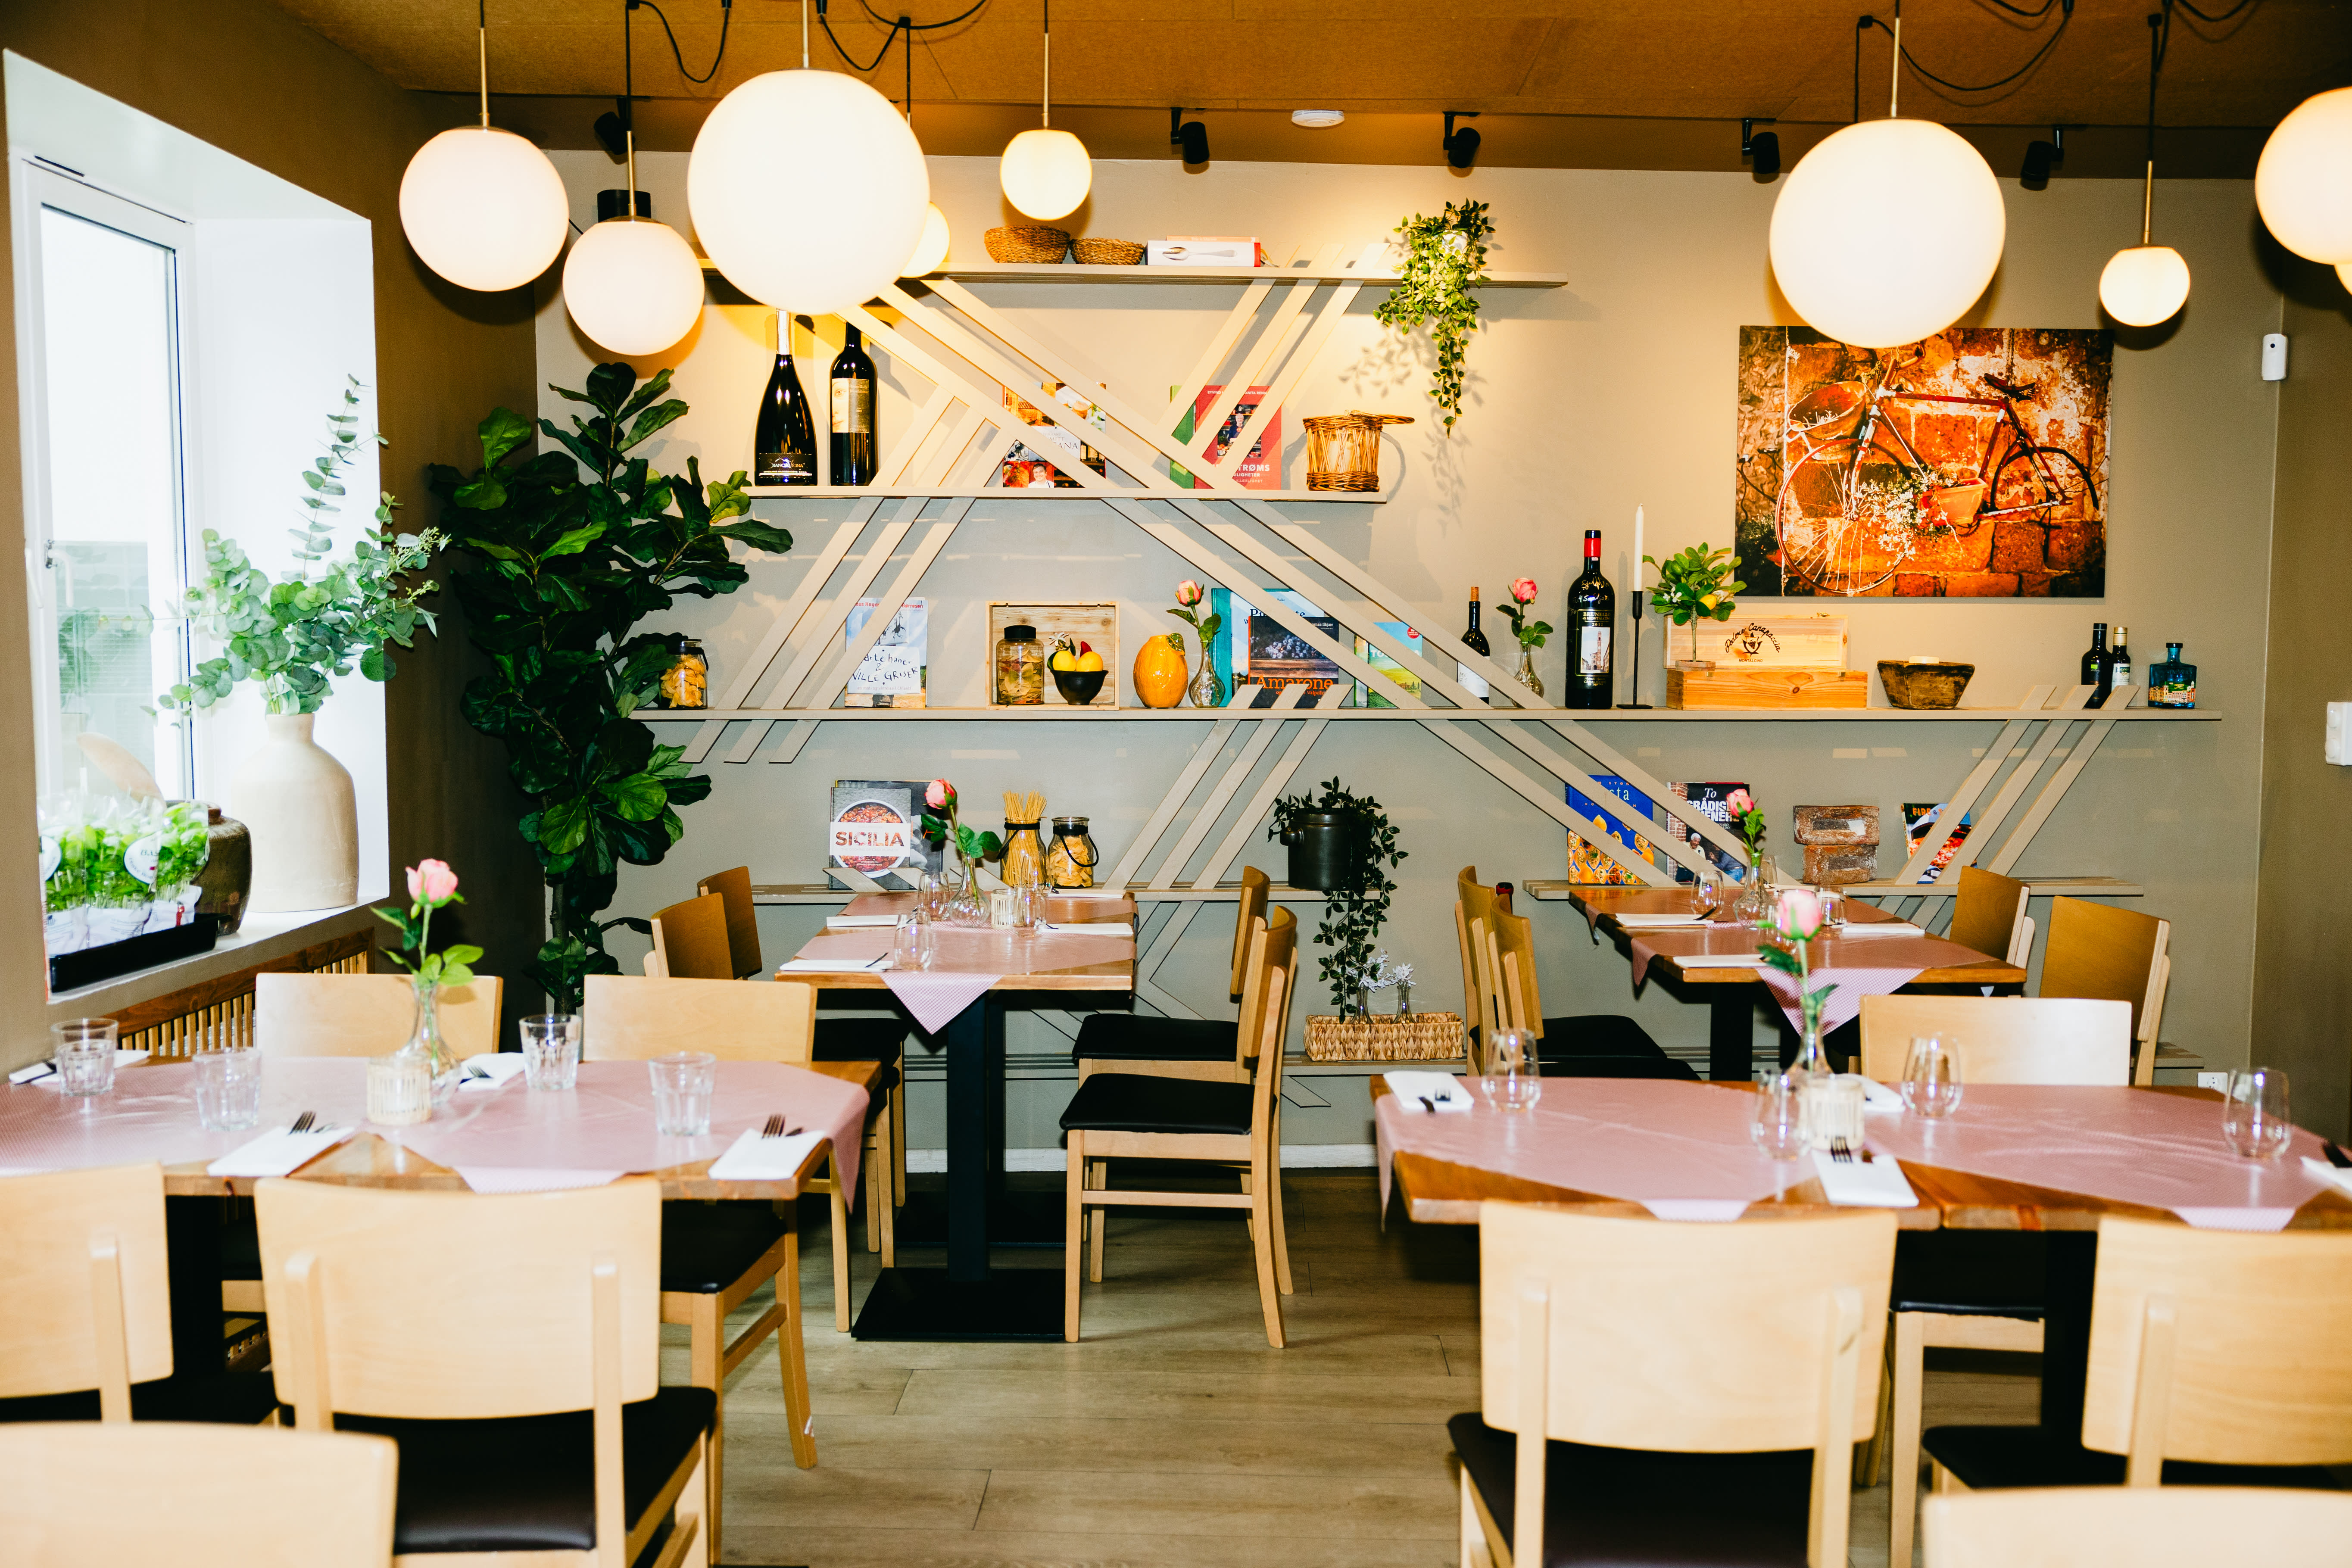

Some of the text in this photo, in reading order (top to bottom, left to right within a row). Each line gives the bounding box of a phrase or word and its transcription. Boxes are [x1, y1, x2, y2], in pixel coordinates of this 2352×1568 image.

[1748, 623, 1781, 653] Canapaccia
[864, 653, 911, 665] arte haner
[875, 663, 884, 671] &
[884, 666, 918, 681] GRISER
[1257, 675, 1334, 689] Amarone
[1610, 787, 1629, 800] ta
[1704, 788, 1717, 798] To
[1686, 798, 1729, 811] RÅDIG
[1912, 808, 1931, 816] FIRE
[836, 831, 905, 847] SICILIA
